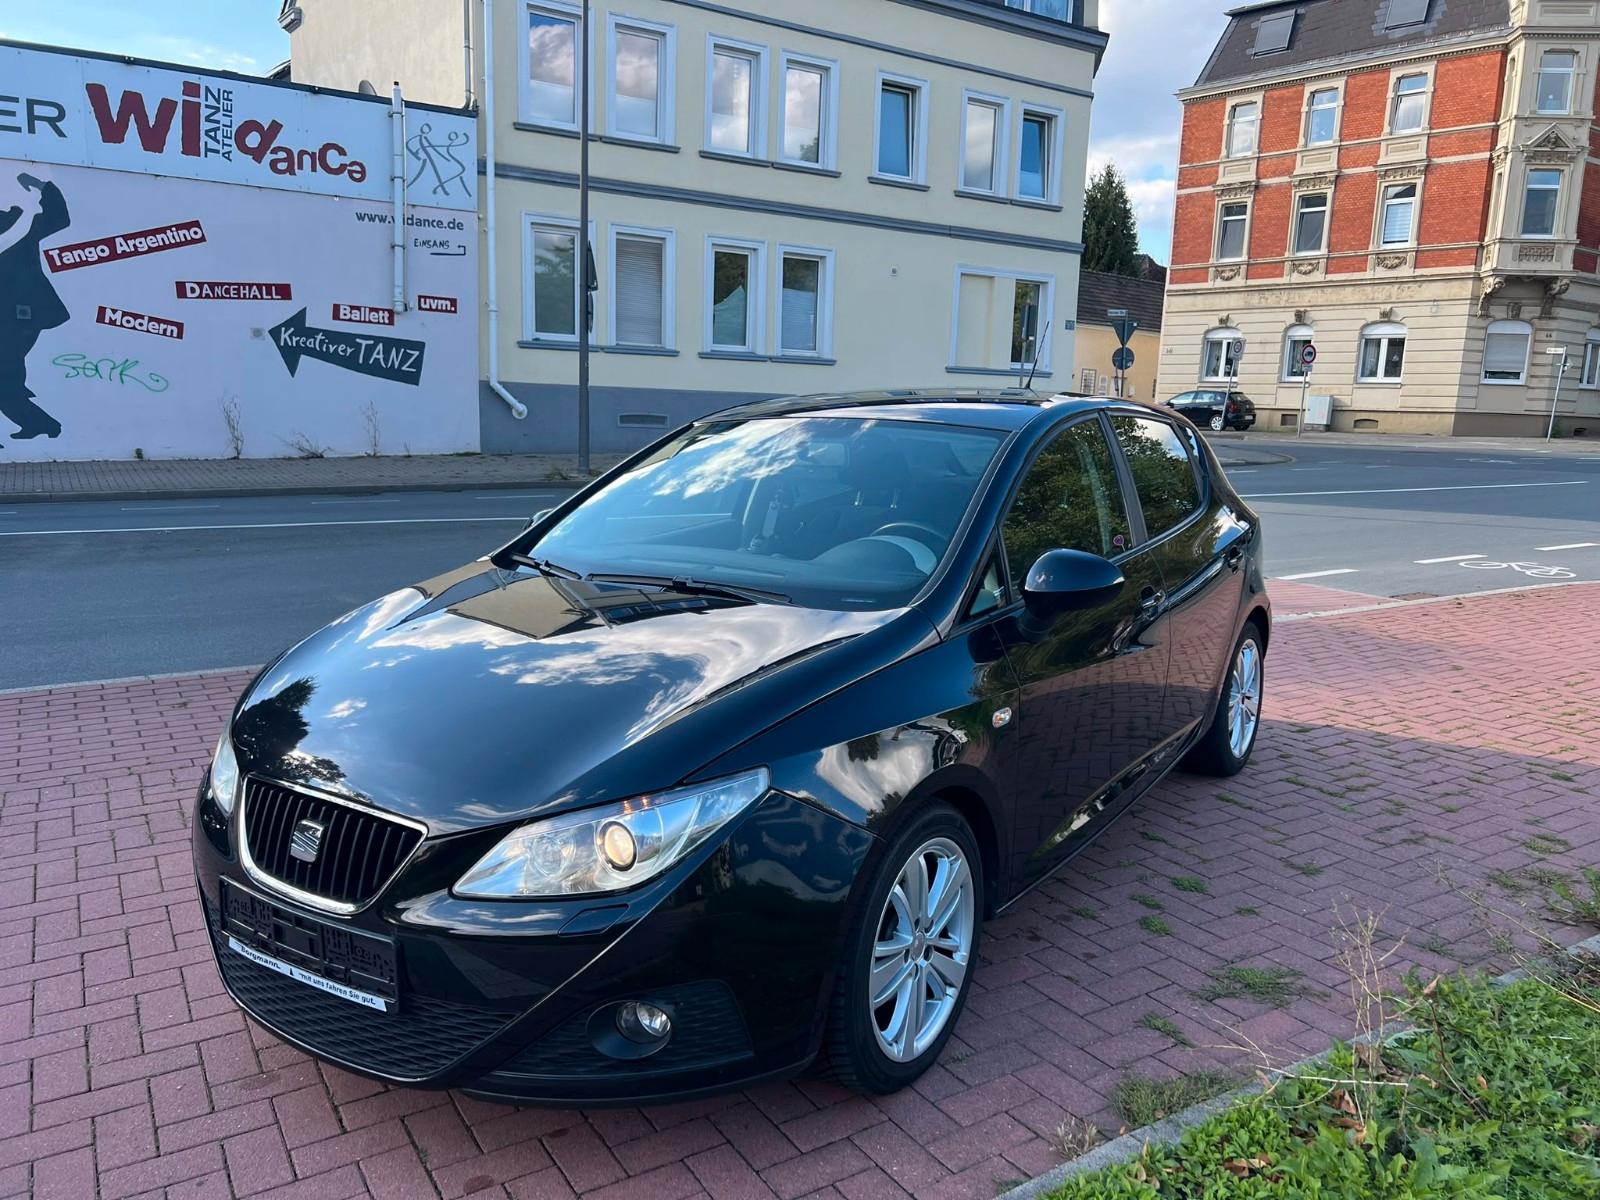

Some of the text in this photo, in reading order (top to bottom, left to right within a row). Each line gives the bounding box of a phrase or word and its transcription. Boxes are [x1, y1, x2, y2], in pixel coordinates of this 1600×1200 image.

[204, 85, 221, 158] TANZ
[222, 89, 233, 163] ATELIER
[355, 212, 465, 231] www.idance.de
[48, 226, 203, 266] Tango Argentino
[339, 304, 390, 324] Ballett
[420, 298, 456, 312] uvm.
[104, 308, 178, 338] Modern
[280, 327, 420, 373] Kreativer TANZ
